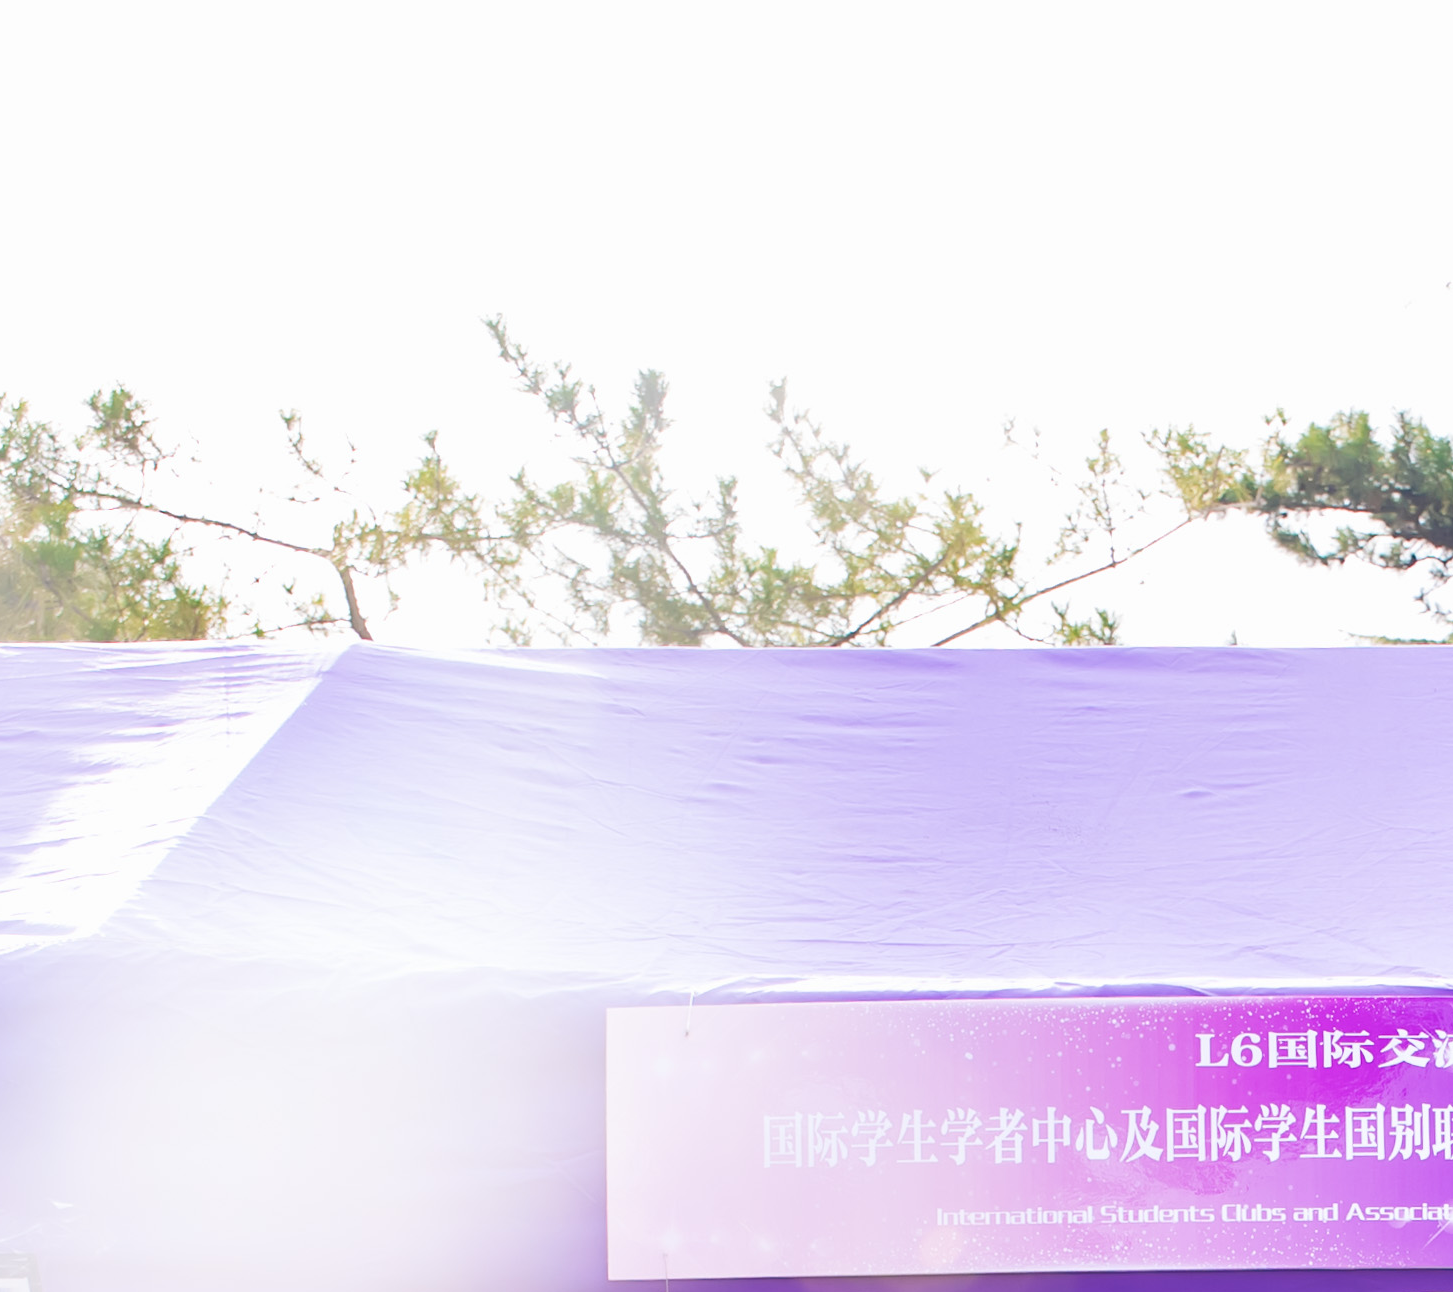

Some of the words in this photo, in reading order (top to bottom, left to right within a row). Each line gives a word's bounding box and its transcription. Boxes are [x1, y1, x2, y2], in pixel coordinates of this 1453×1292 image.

[935, 1206, 1095, 1228] International
[1100, 1204, 1217, 1226] Students
[1221, 1203, 1288, 1224] Clubs
[1293, 1203, 1340, 1223] and
